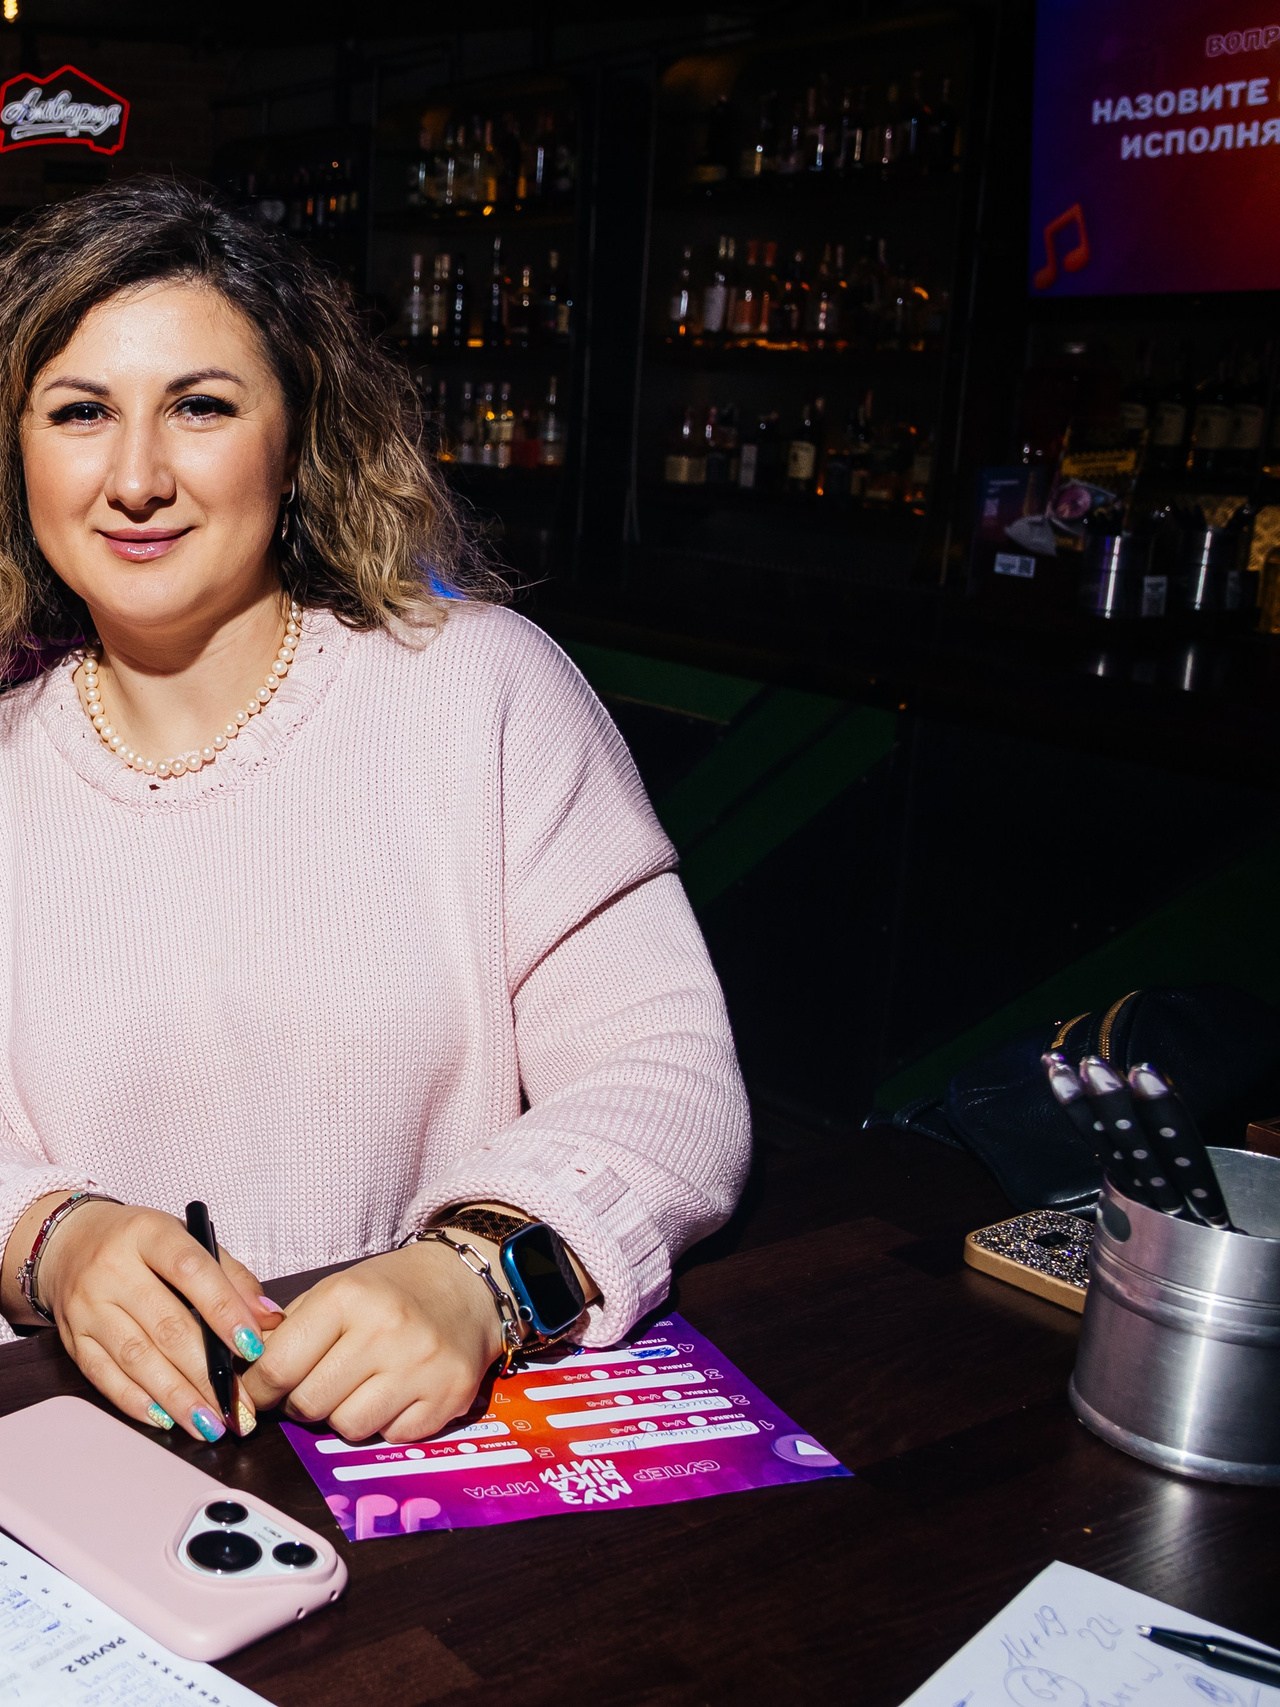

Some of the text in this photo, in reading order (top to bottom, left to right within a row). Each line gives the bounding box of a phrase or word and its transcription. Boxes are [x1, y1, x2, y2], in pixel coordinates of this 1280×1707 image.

[1091, 77, 1270, 124] НАЗОВИТЕ
[704, 1368, 723, 1380] 3
[494, 1392, 511, 1404] 7
[729, 1394, 750, 1405] 2
[512, 1419, 532, 1431] 6
[634, 1459, 721, 1483] СУПЕР
[462, 1480, 540, 1500] ИГРА
[560, 1480, 633, 1505] МУЗ
[60, 1637, 126, 1673] РАУНД 2
